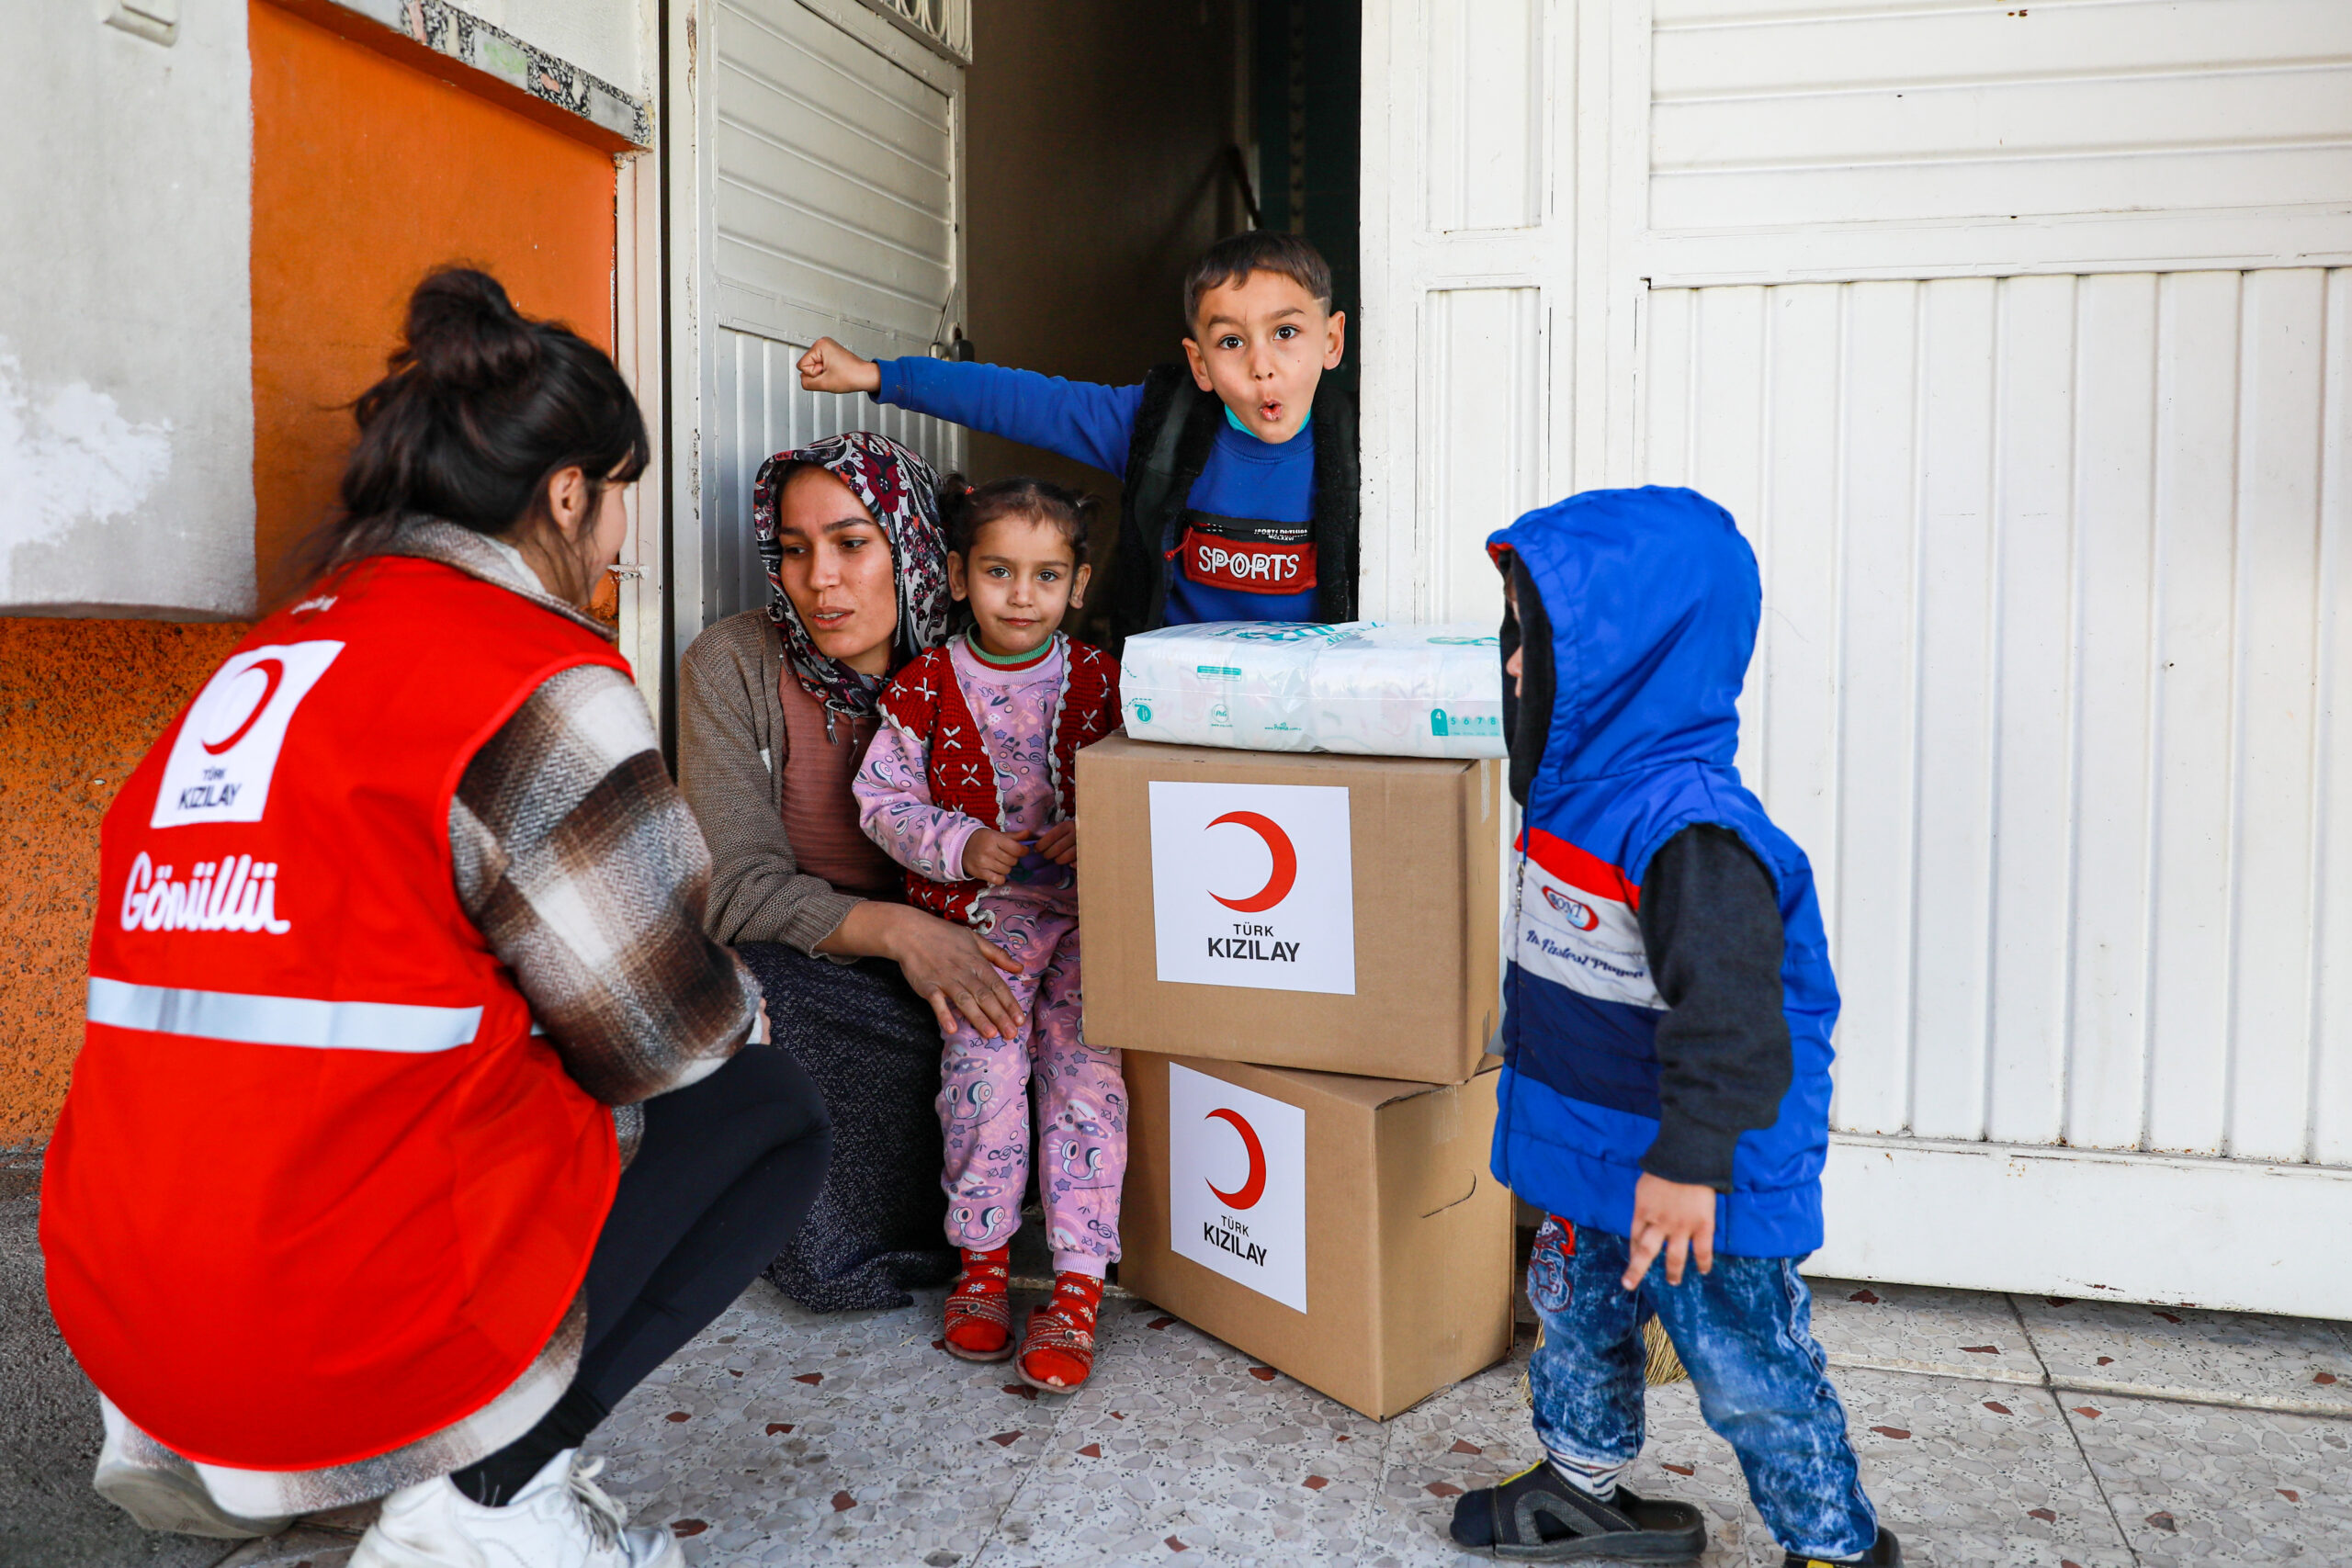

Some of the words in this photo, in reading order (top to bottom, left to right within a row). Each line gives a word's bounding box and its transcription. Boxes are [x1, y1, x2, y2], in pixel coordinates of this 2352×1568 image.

[1198, 545, 1300, 581] SPORTS
[1435, 711, 1442, 720] 4
[1451, 716, 1457, 726] 5
[1463, 716, 1470, 726] 6
[1476, 716, 1483, 726] 7
[1489, 716, 1497, 726] 8
[177, 783, 242, 810] KIZILAY
[121, 851, 291, 935] Gönüllü
[1233, 921, 1274, 938] TÜRK
[1207, 937, 1301, 963] KIZILAY
[1221, 1215, 1250, 1238] TÜRK
[1204, 1221, 1268, 1268] KIZILAY
